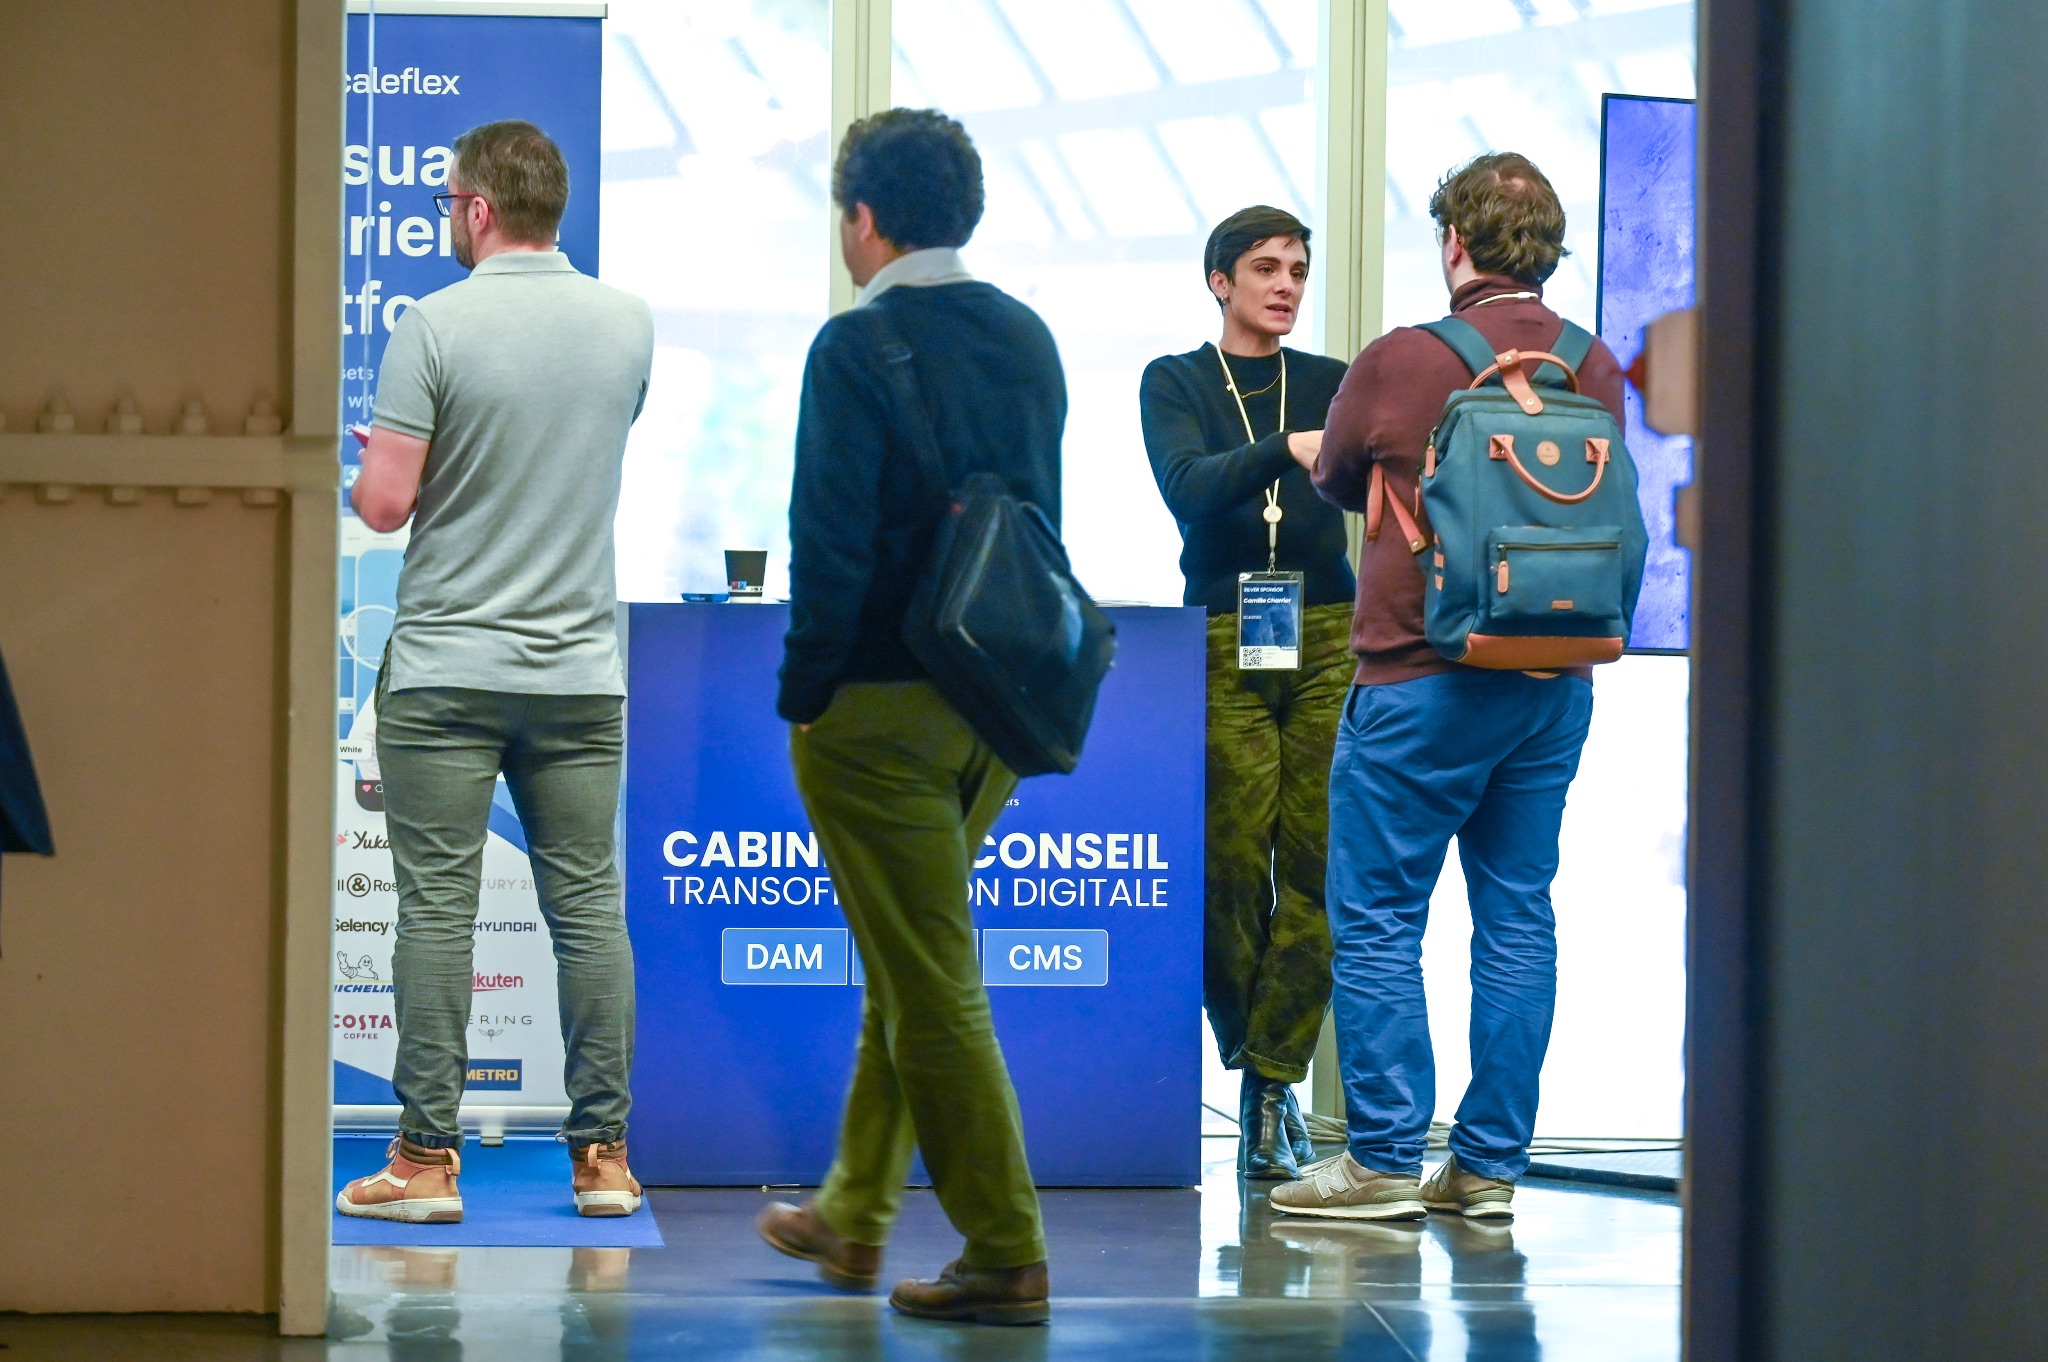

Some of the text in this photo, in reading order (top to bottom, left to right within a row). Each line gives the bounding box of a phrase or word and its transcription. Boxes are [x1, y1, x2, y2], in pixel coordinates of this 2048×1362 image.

[339, 746, 363, 754] White
[662, 830, 828, 868] CABIN
[1013, 878, 1169, 907] DIGITALE
[474, 922, 537, 932] HYUNDAI
[747, 943, 1083, 971] DAM CMS
[467, 1069, 519, 1081] METRO
